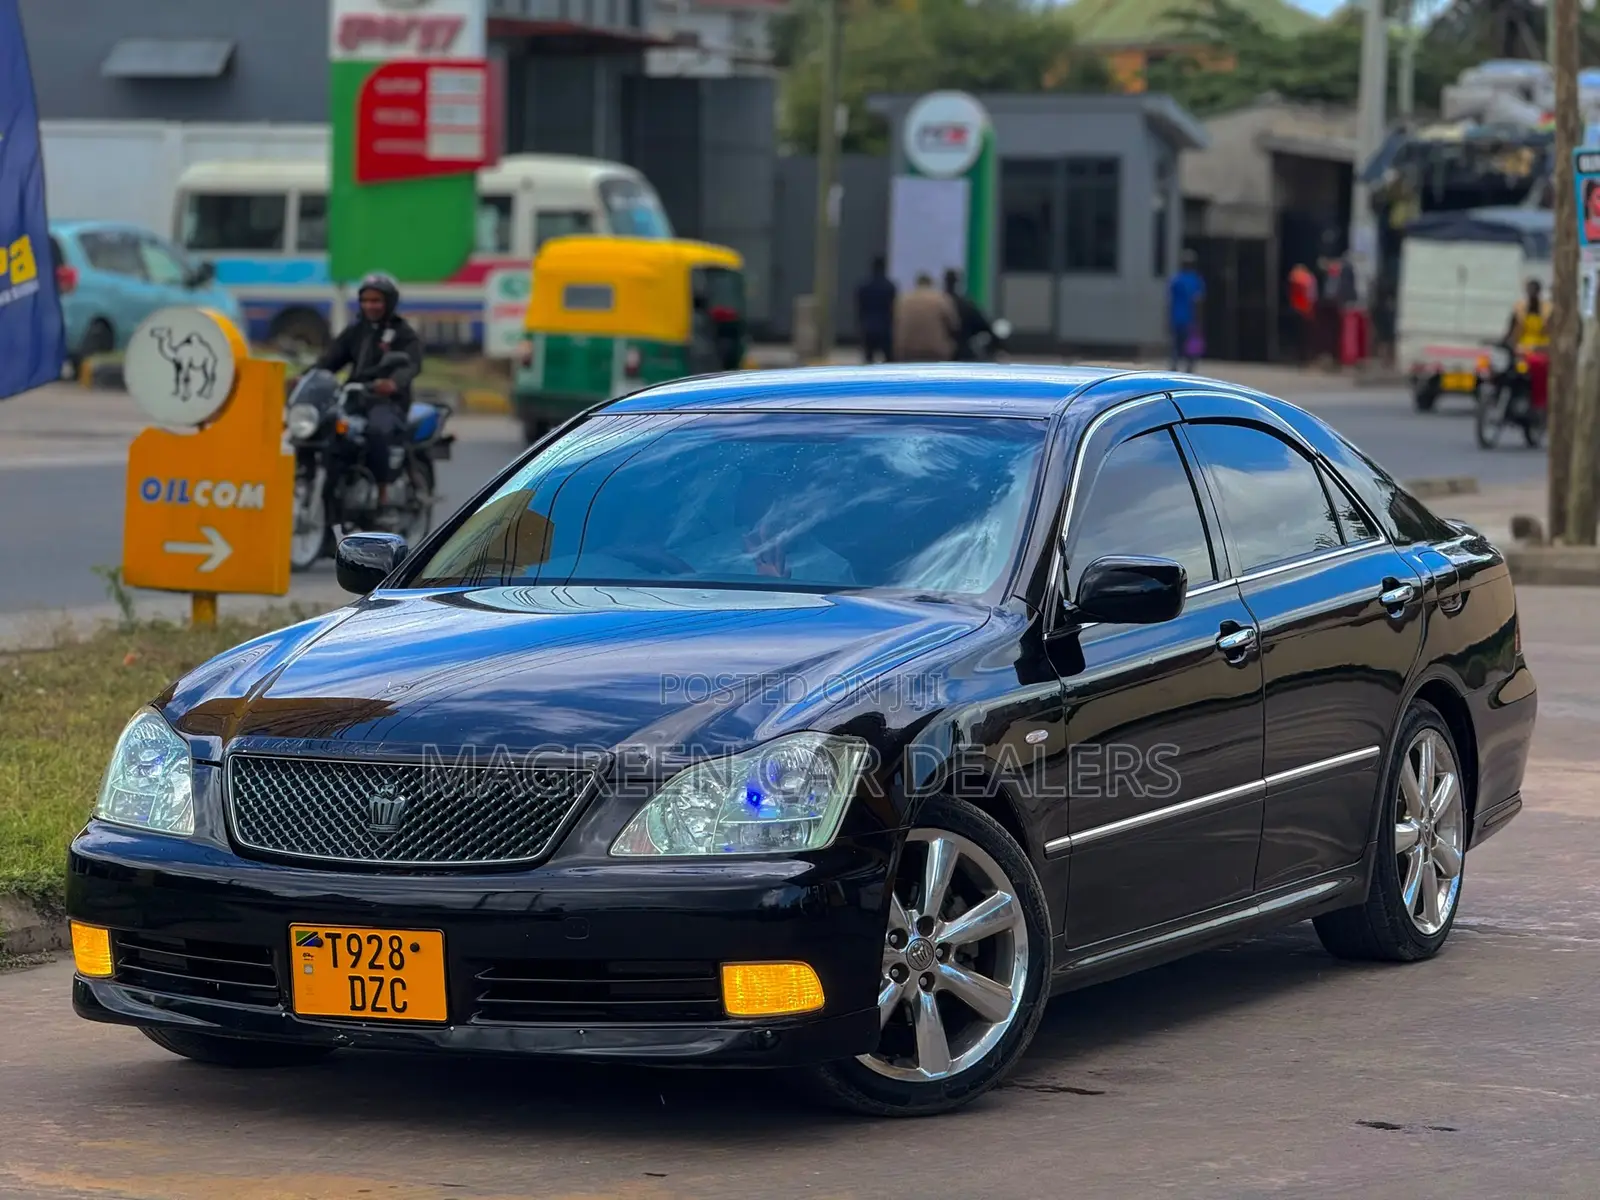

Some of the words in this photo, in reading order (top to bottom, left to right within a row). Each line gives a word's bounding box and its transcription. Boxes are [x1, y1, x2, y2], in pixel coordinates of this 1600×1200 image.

[140, 476, 266, 510] OILCOM
[324, 932, 406, 971] T928
[347, 974, 408, 1013] DZC
